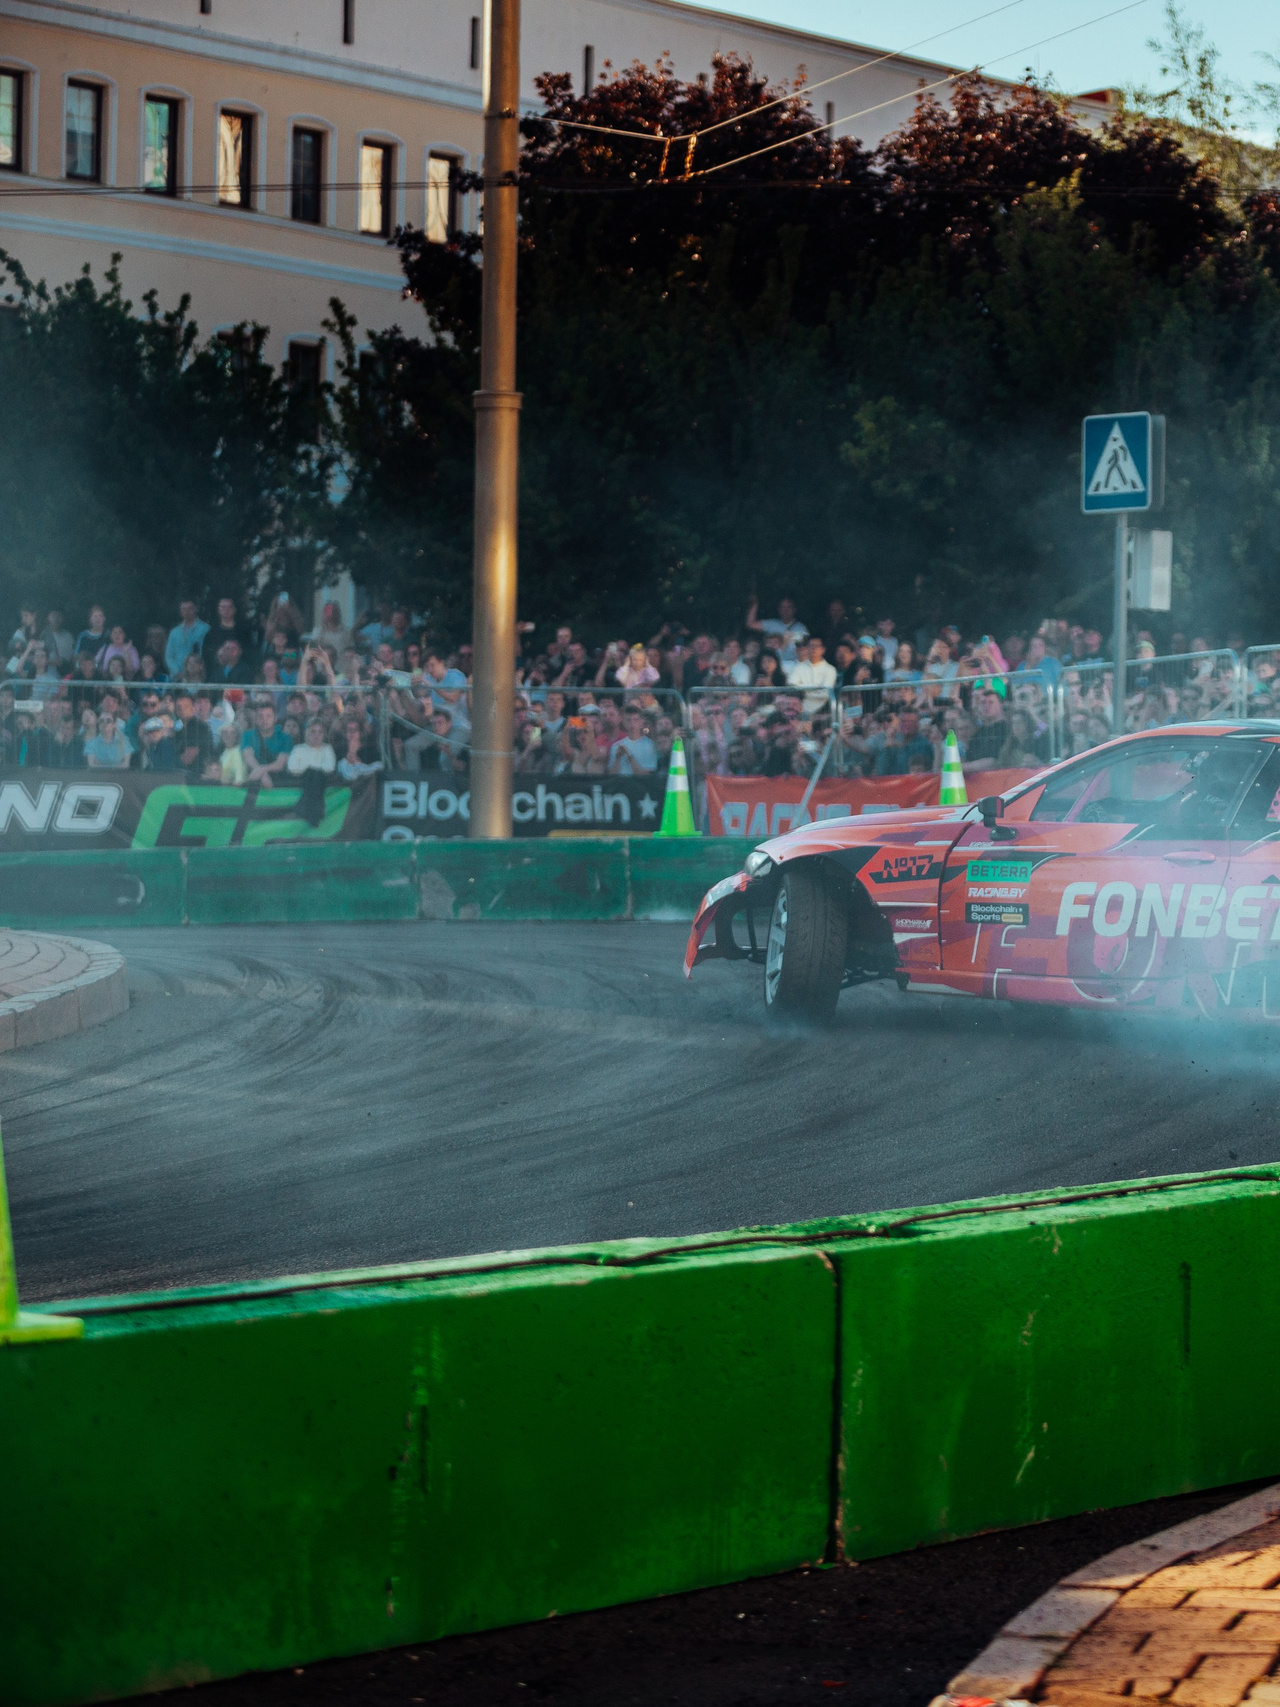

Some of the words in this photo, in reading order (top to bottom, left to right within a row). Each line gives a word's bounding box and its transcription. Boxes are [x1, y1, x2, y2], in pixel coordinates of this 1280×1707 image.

[383, 780, 632, 823] Blochain
[971, 904, 1018, 913] Blockchain
[971, 912, 1000, 922] Sports
